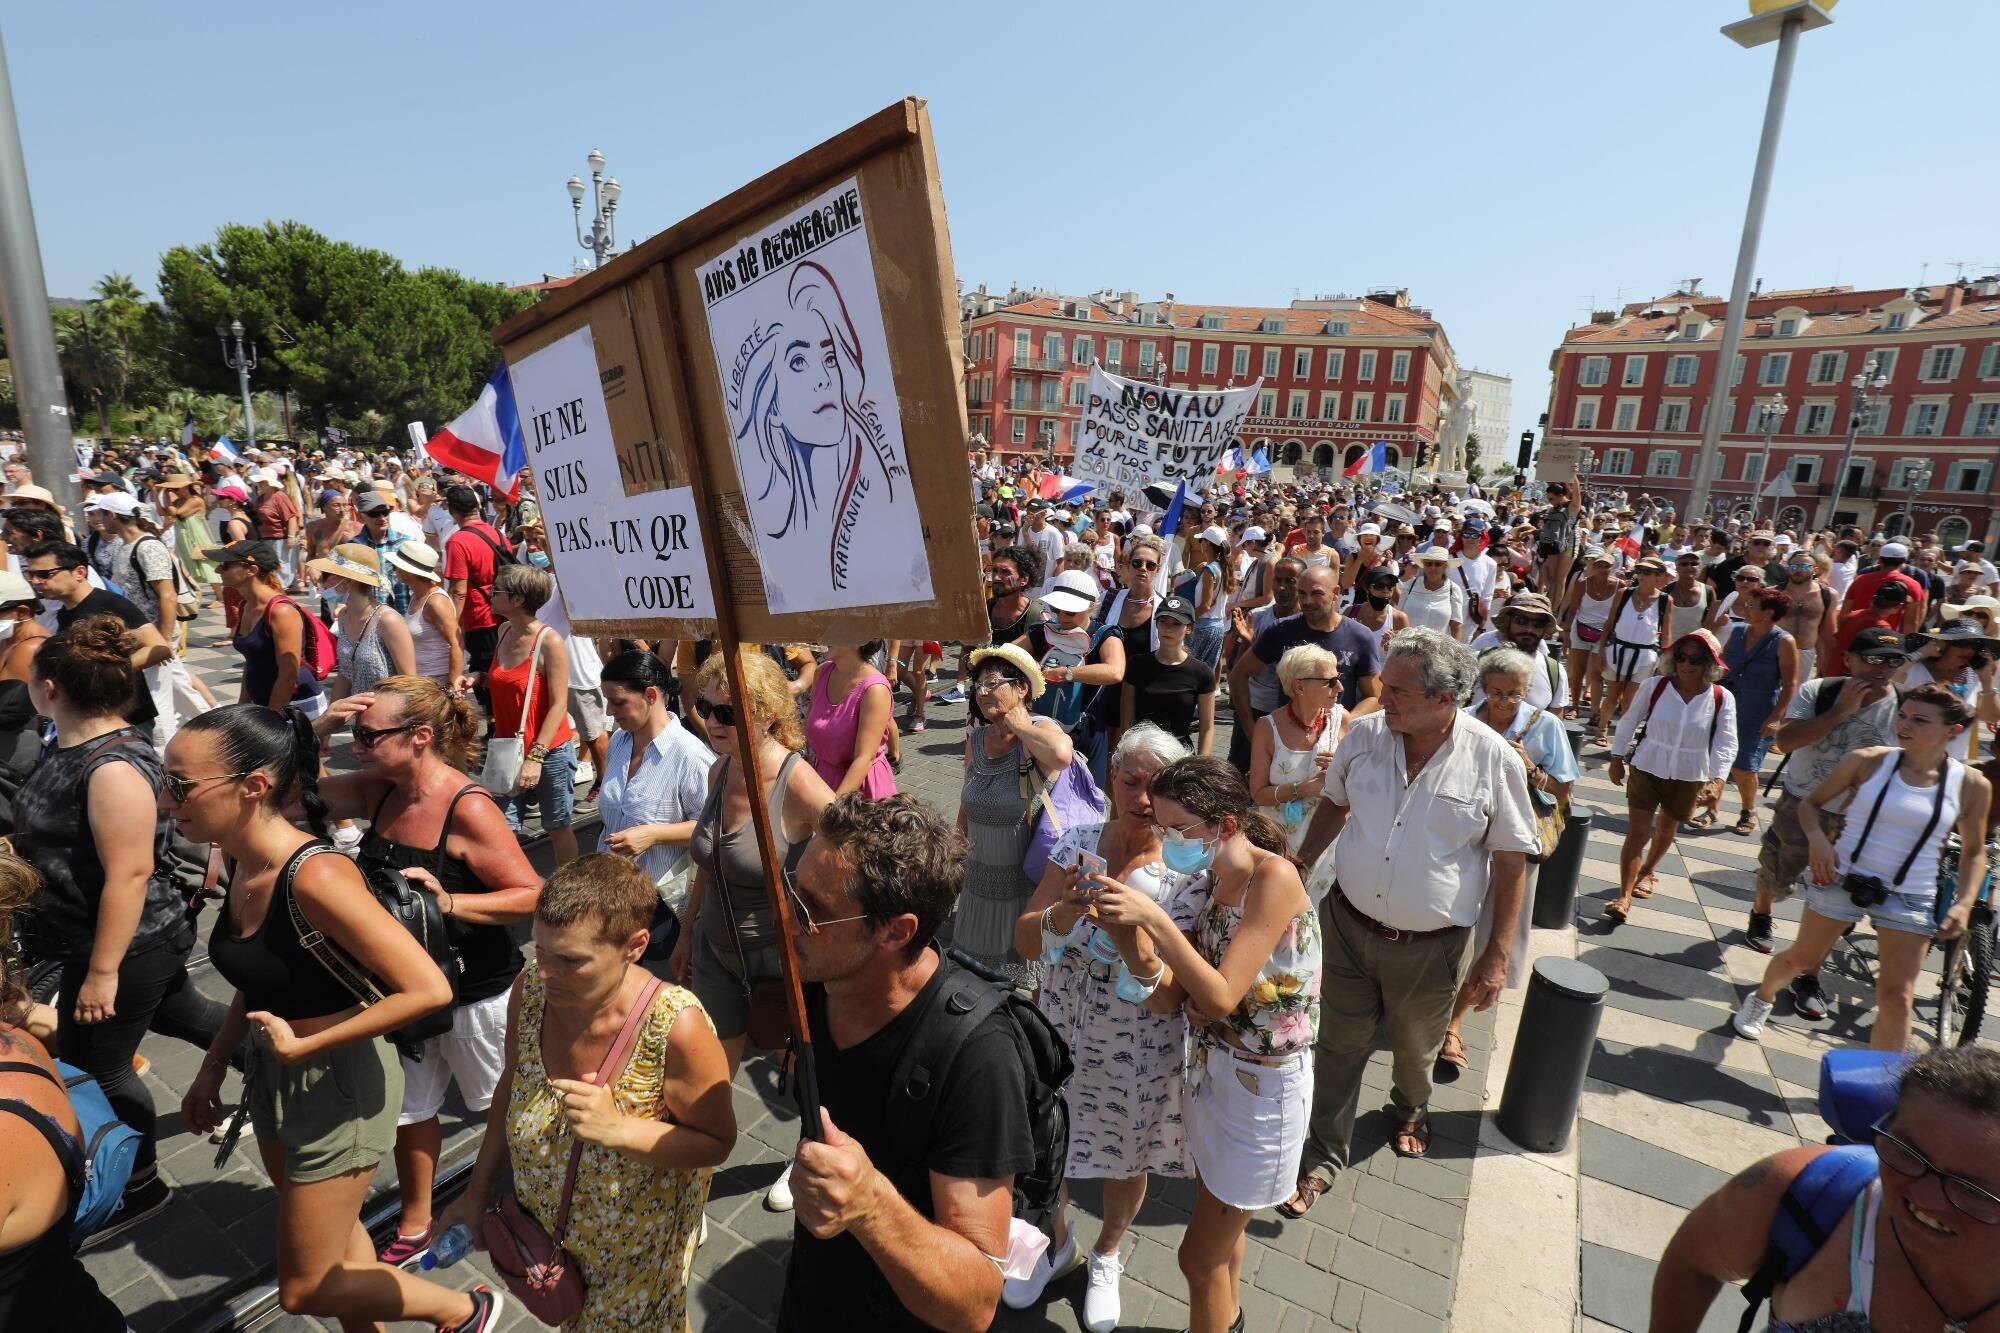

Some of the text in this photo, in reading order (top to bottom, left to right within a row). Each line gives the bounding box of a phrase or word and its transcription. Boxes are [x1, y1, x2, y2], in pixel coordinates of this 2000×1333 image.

[736, 246, 759, 285] de
[760, 188, 862, 272] RECHERCHE
[728, 319, 763, 411] LIBERTÉ
[556, 398, 587, 441] NE
[1088, 394, 1140, 432] PASS
[1121, 385, 1225, 418] NON AU
[859, 400, 906, 480] ÉGALITÉ
[1085, 419, 1126, 448] POUR
[1126, 436, 1149, 455] LE
[1085, 441, 1109, 458] de
[1113, 452, 1152, 473] nos
[544, 459, 588, 502] SUIS
[1896, 503, 1963, 514] Smsonite
[650, 514, 690, 561] QR
[624, 575, 695, 609] CODE
